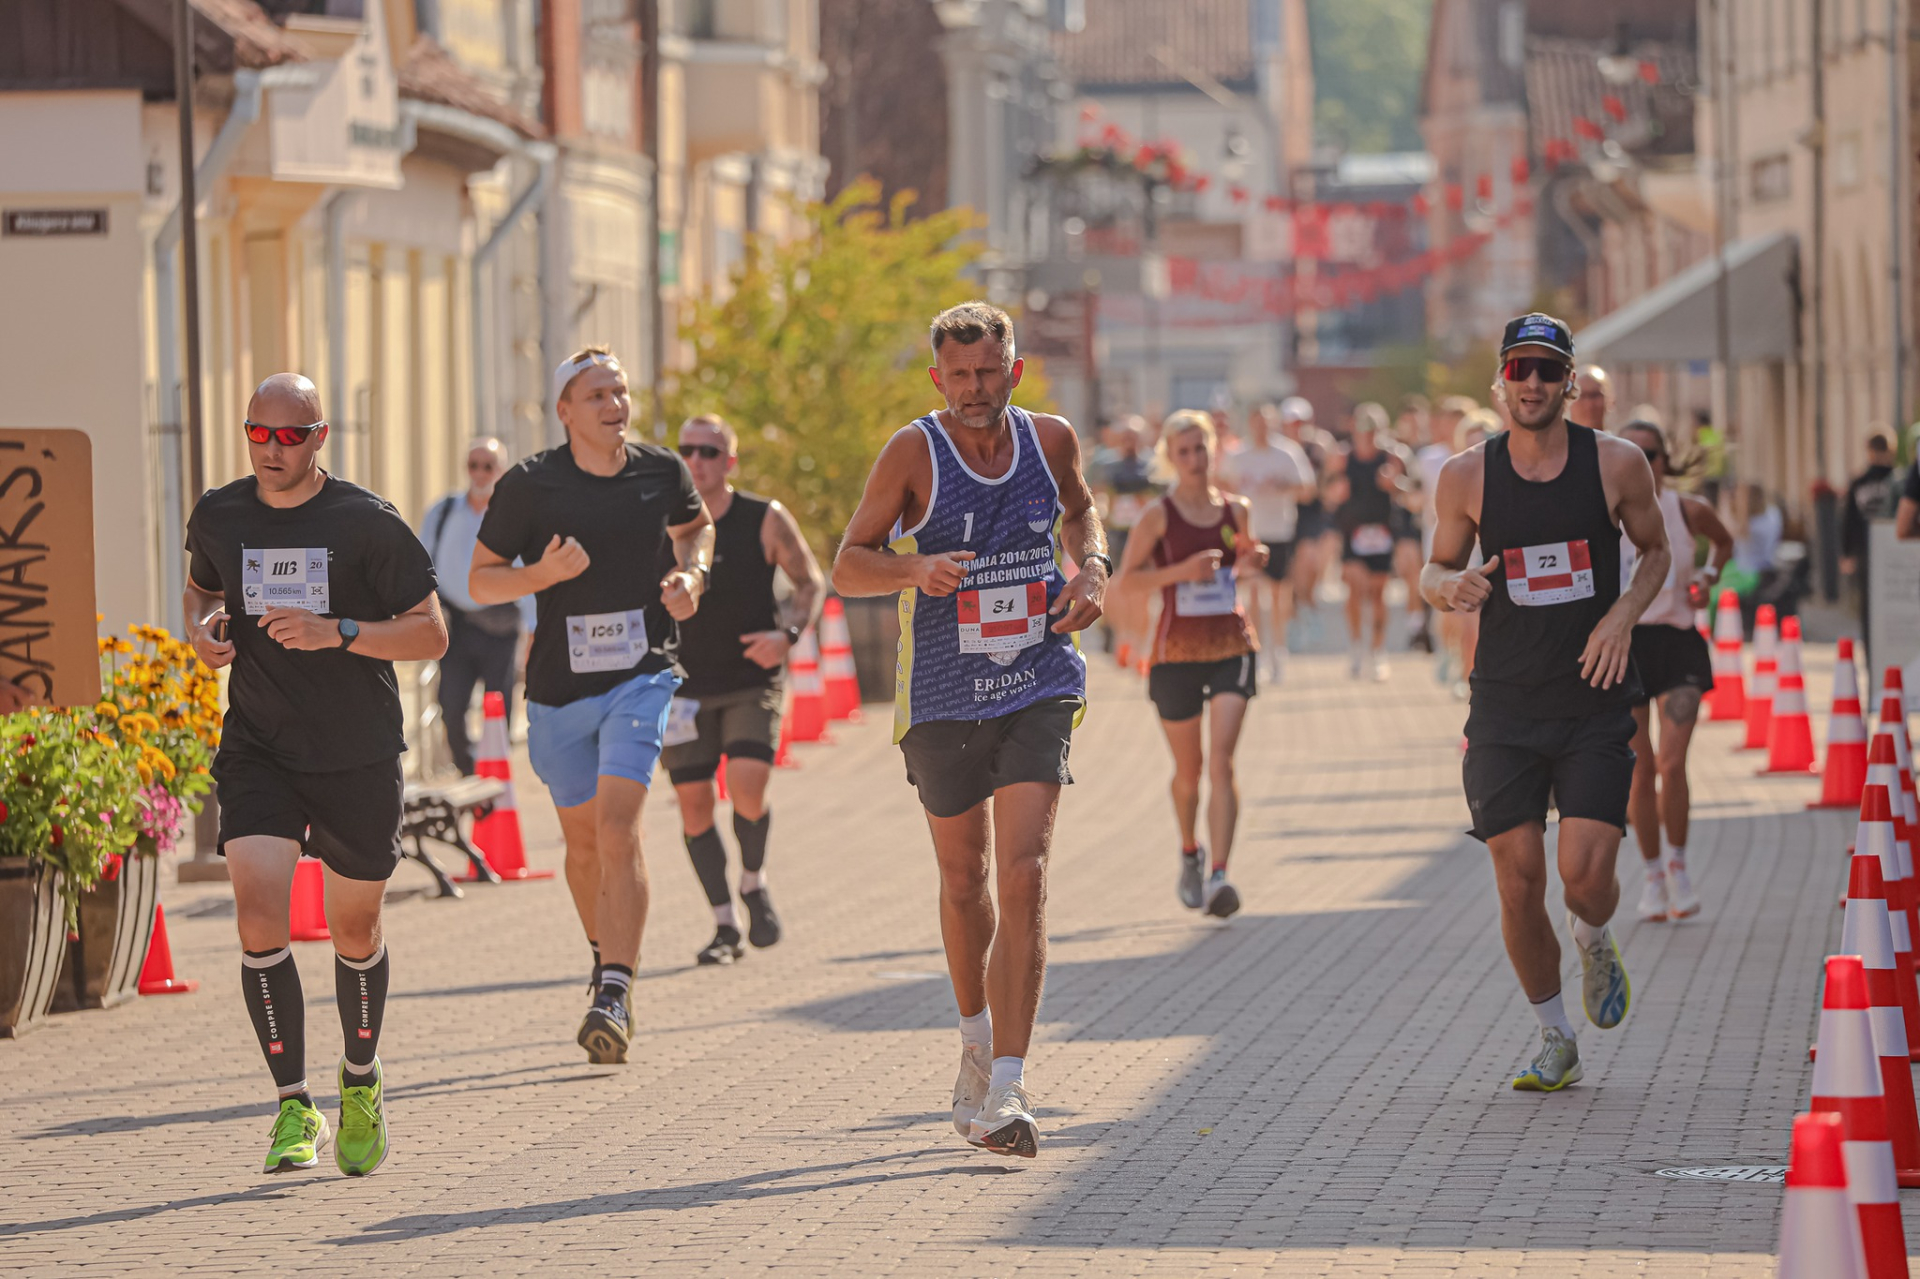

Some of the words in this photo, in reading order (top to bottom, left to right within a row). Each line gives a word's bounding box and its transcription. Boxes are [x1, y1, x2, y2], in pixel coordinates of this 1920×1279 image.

[963, 511, 975, 543] 1
[271, 561, 297, 575] 1113
[309, 561, 323, 569] 20
[959, 555, 997, 572] RMALA
[1000, 545, 1050, 565] 2014/2015
[1539, 555, 1557, 568] 72
[269, 587, 292, 595] 10.565
[993, 598, 1015, 614] 84
[591, 623, 624, 638] 1069
[974, 668, 1036, 692] ERIDAN
[974, 692, 988, 702] ice
[990, 690, 1007, 701] age
[1009, 680, 1037, 696] water
[259, 972, 278, 1039] COMPRESSPORT
[358, 972, 368, 1028] COMPRESSPORT
